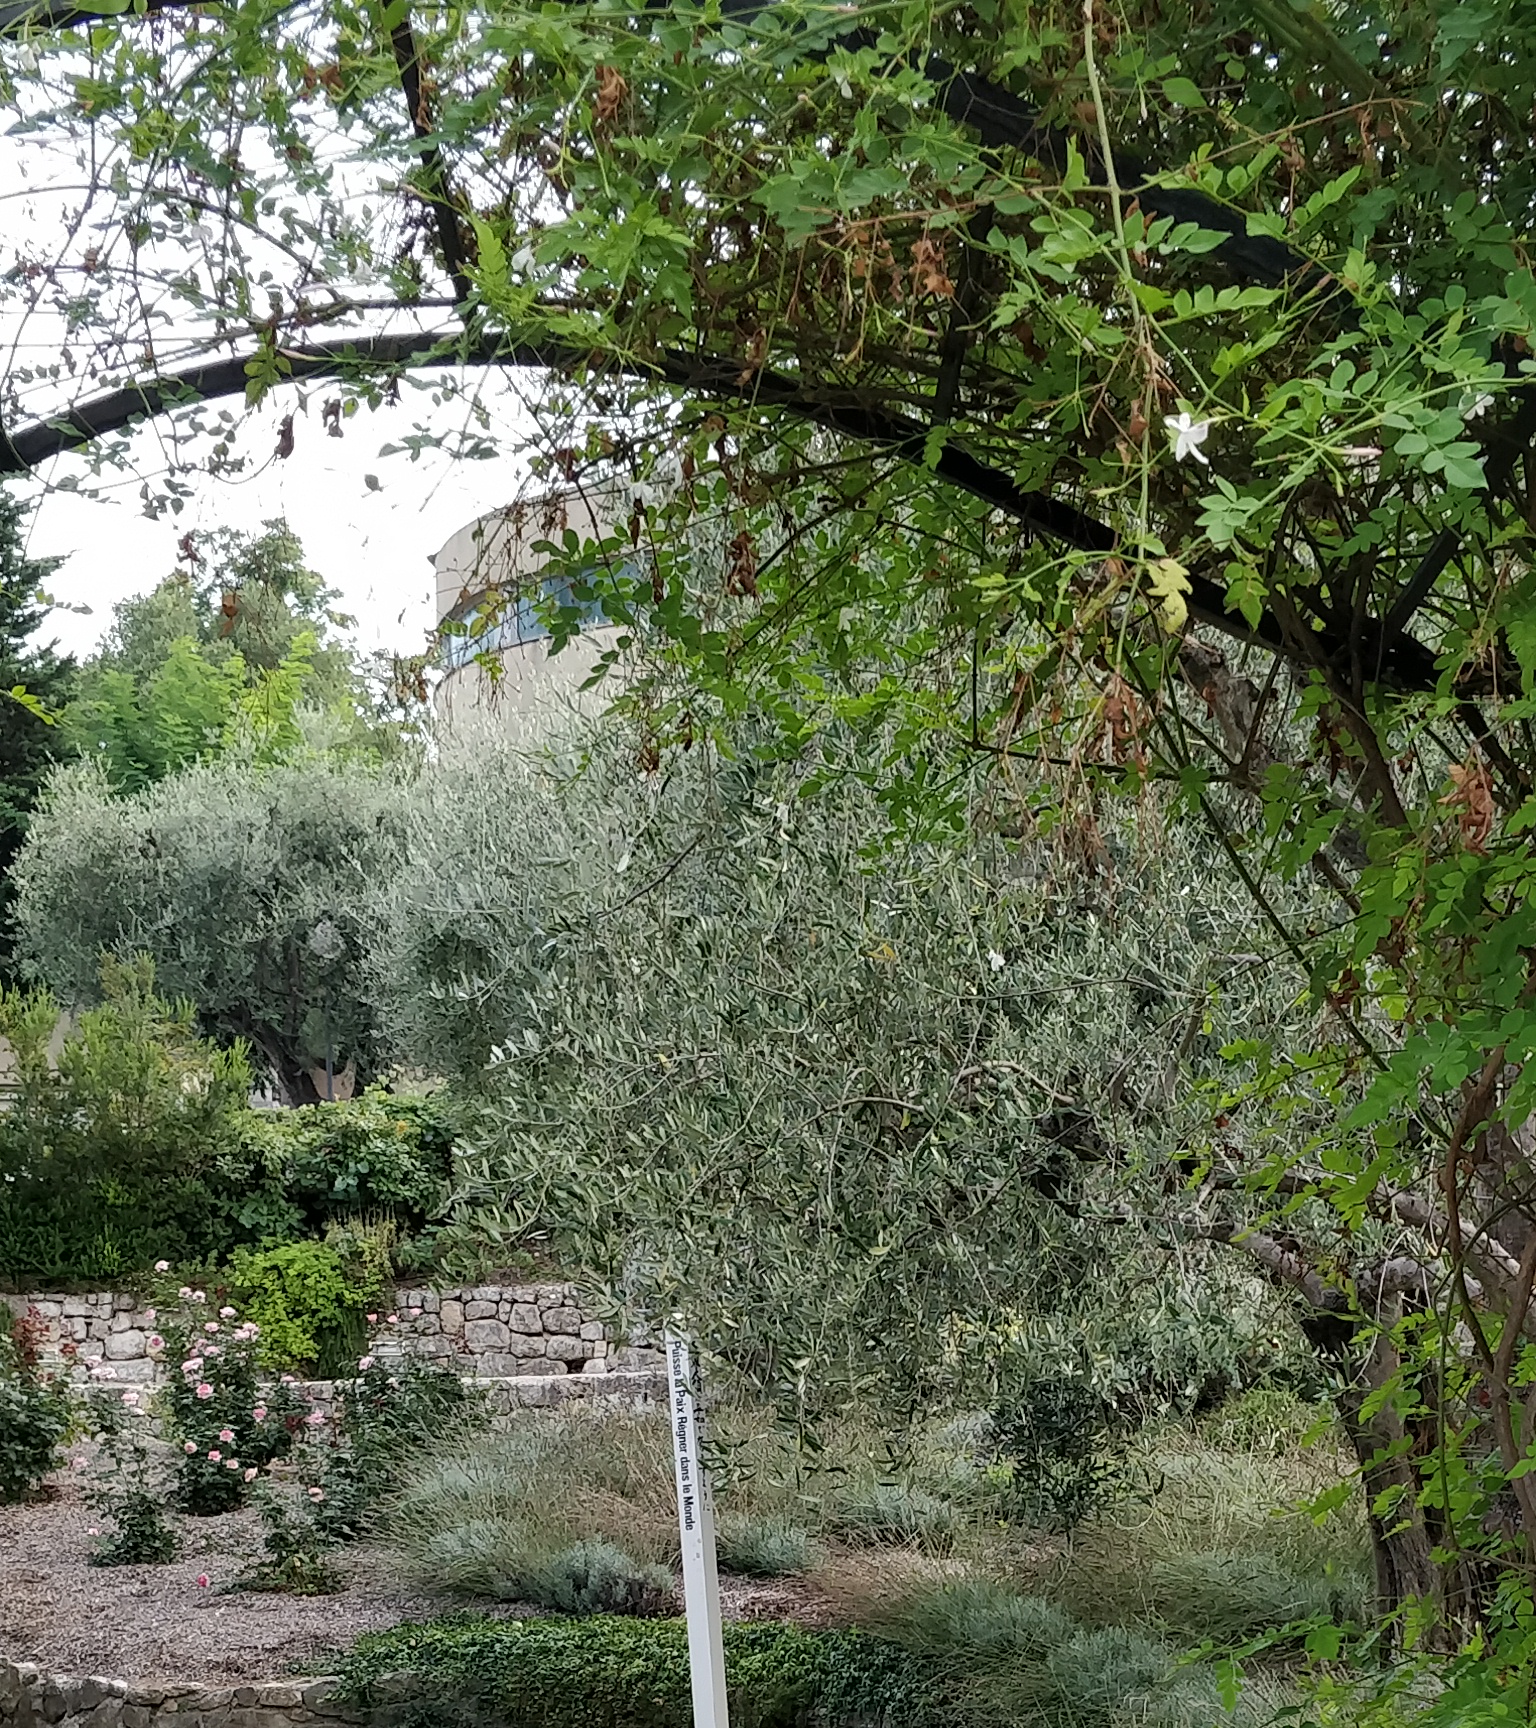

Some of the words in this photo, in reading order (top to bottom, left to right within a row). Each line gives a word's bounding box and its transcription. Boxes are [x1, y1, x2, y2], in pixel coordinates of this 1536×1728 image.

[672, 1341, 683, 1376] Puisse
[675, 1389, 687, 1414] Paix
[675, 1416, 688, 1453] Régner
[679, 1457, 691, 1482] dans
[683, 1496, 696, 1531] Monde
